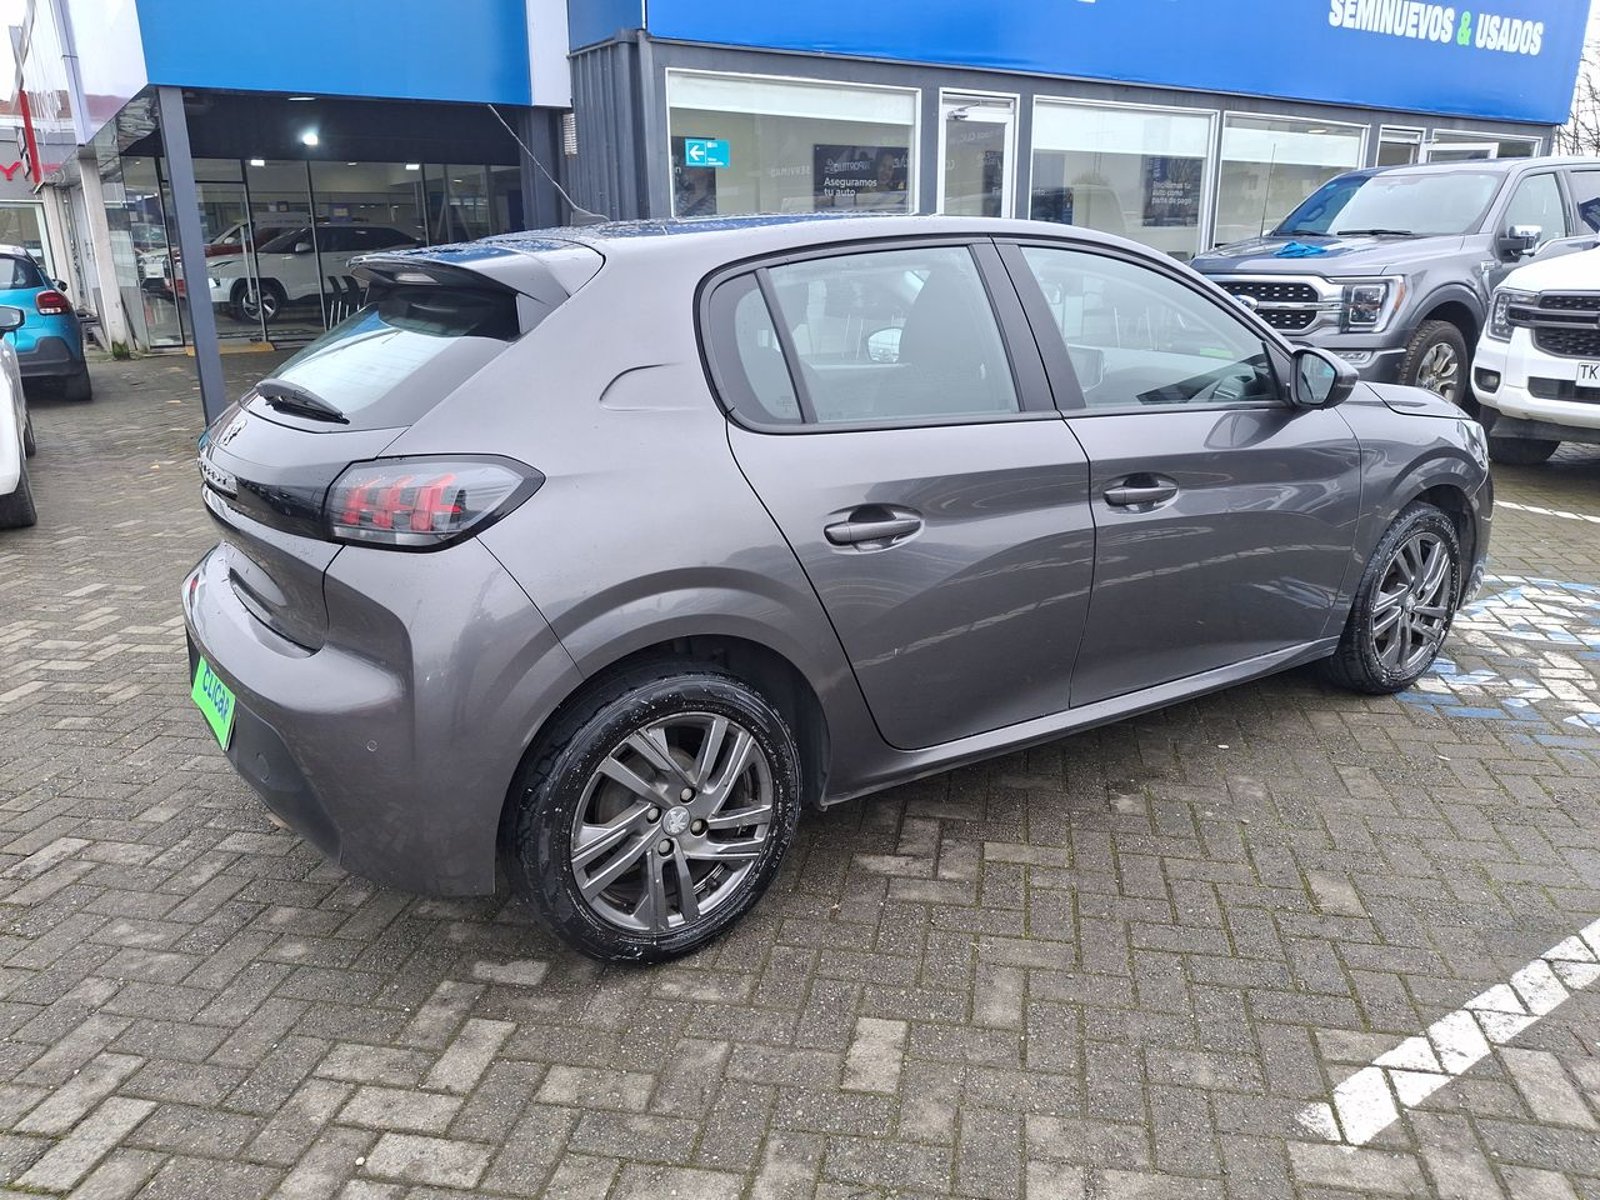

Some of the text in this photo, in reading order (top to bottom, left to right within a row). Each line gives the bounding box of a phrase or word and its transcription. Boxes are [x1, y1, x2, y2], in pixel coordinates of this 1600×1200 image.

[1329, 0, 1544, 56] SEMINUEVOS & USADOS
[824, 178, 877, 188] Aseguramos
[823, 188, 856, 197] tu auto
